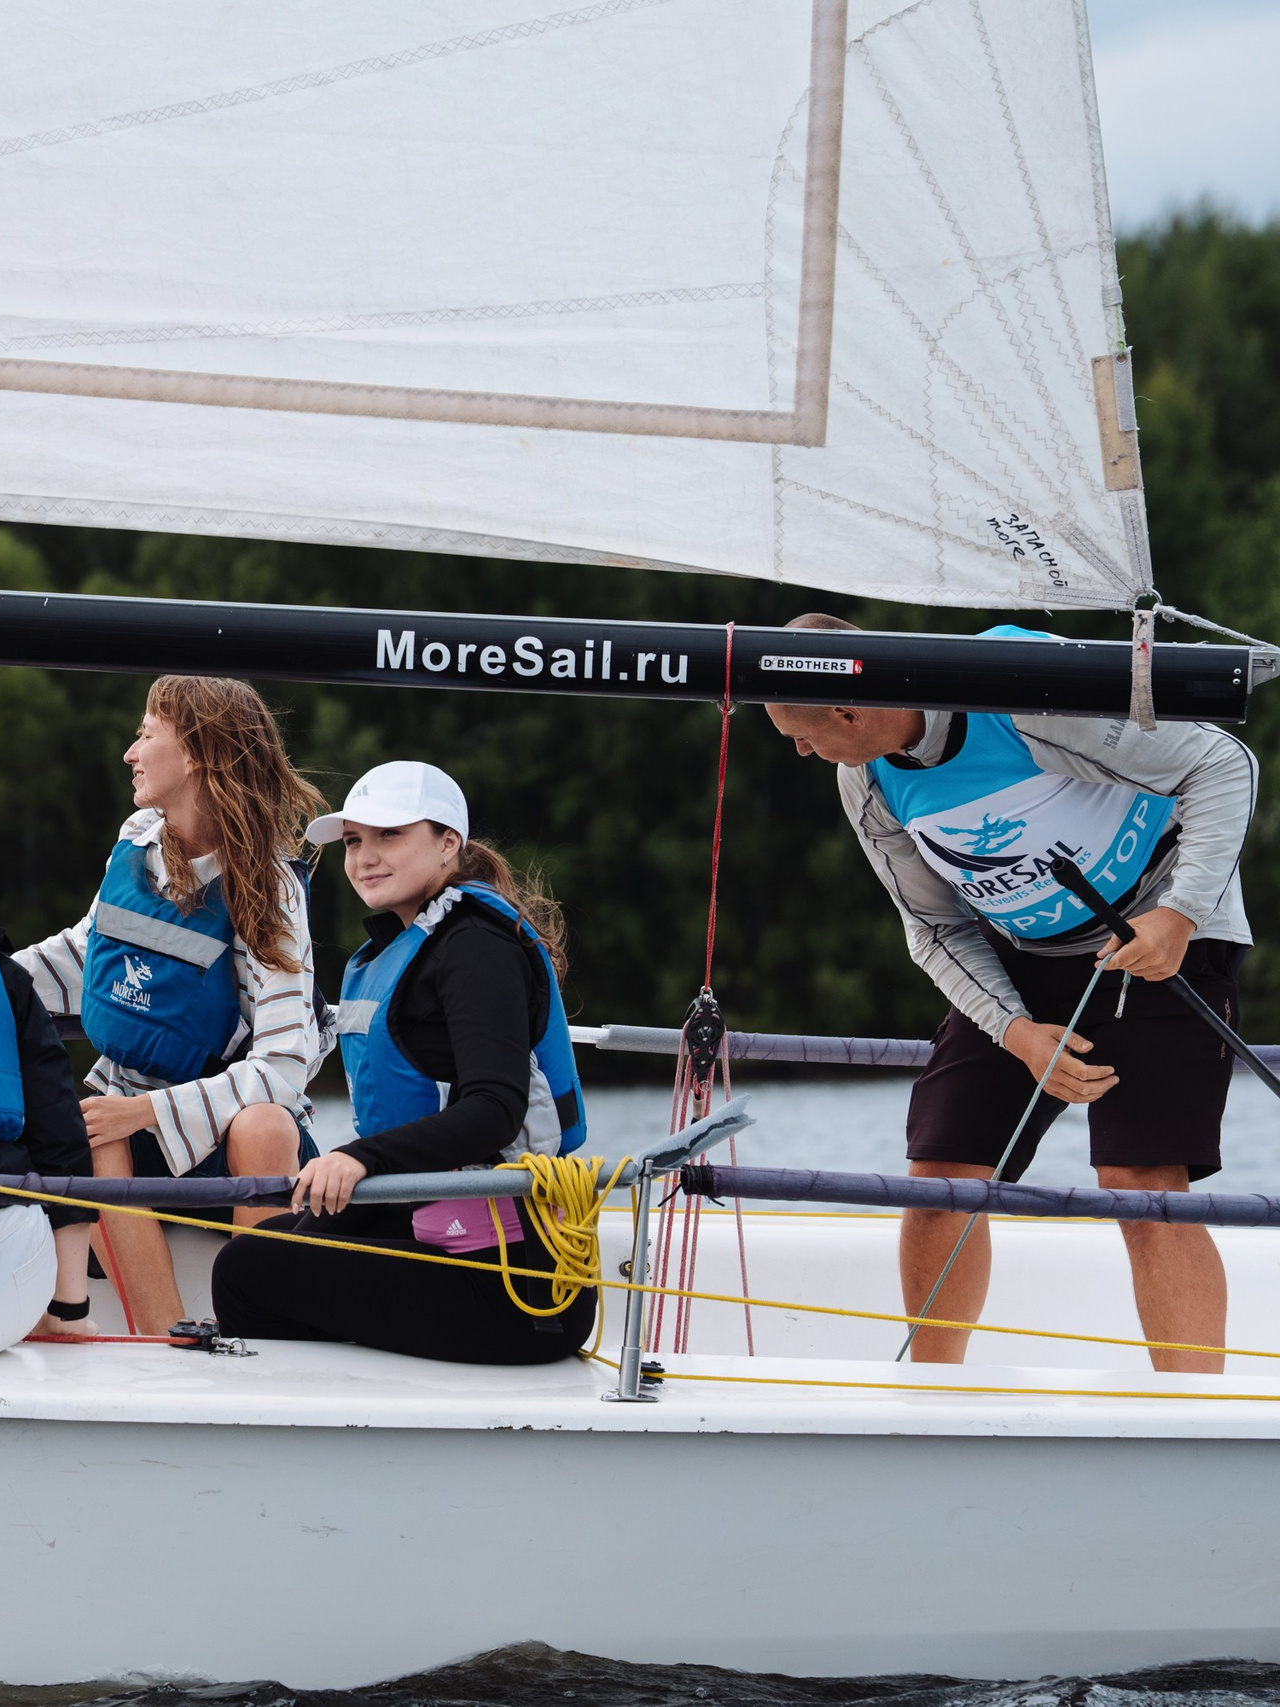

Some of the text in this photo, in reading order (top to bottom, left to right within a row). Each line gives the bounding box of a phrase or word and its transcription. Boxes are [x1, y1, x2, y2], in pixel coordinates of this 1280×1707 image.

[376, 629, 688, 684] MoreSail.ru
[777, 659, 847, 671] BROTHERS
[111, 980, 151, 1007] MORESAIL
